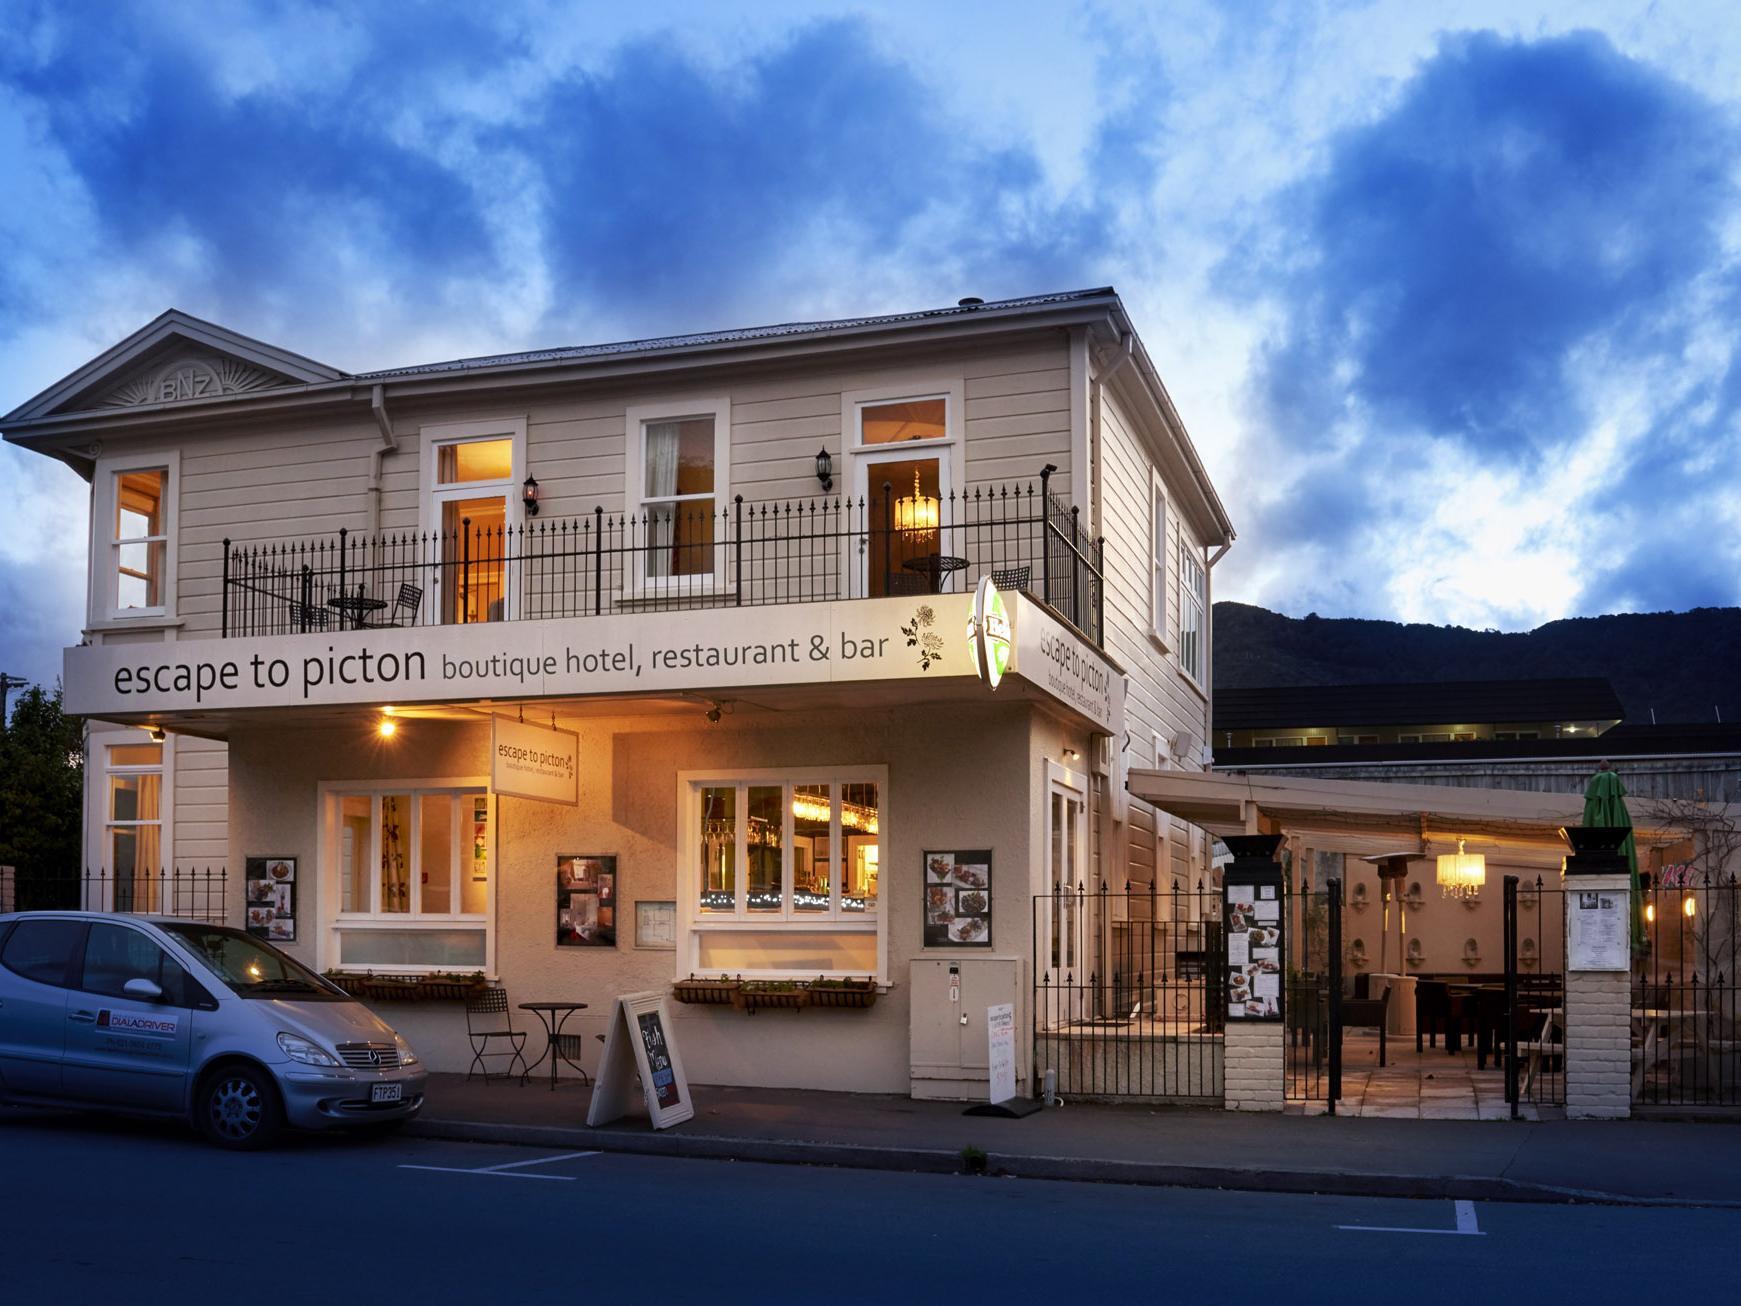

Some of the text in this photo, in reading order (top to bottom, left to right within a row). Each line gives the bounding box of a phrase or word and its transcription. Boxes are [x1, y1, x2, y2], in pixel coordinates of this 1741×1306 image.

[161, 367, 212, 401] BNZ
[114, 631, 889, 703] escape to picton boutique hotel, restaurant & bar
[1041, 627, 1071, 677] escape
[1072, 645, 1080, 678] to
[1081, 653, 1104, 696] picton
[498, 744, 565, 768] escape to picton
[111, 1016, 176, 1032] DIALADRIVER
